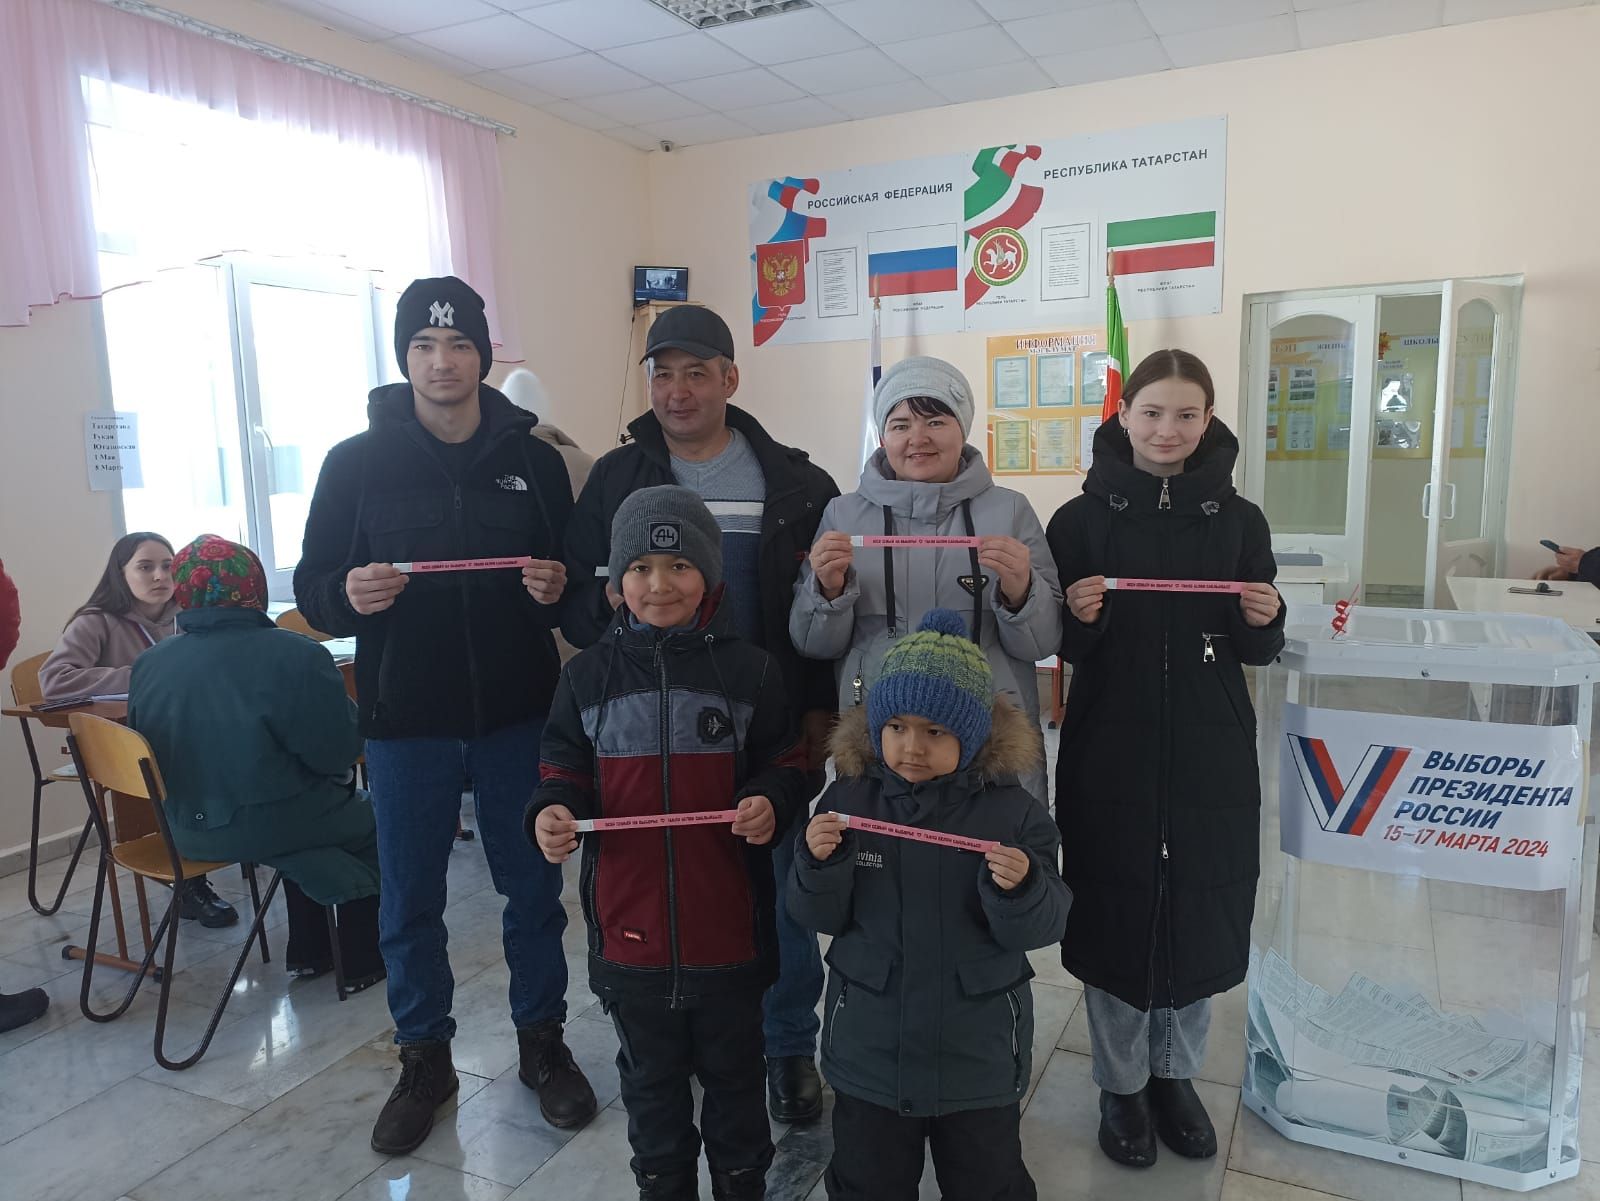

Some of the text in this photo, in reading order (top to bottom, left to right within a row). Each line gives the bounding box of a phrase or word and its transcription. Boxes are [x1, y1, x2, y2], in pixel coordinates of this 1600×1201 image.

[1043, 149, 1208, 180] РЕСПУБЛИКА ТАТАРСТАН
[807, 182, 953, 209] РОССИЙСКАЯ ФЕДЕРАЦИЯ
[429, 300, 455, 327] NY
[1016, 334, 1096, 349] ИНФОРМАЦИЯ
[1422, 750, 1546, 779] ВЫБОРЫ
[1407, 775, 1574, 808] ПРЕЗИДЕНТА
[1393, 800, 1503, 830] РОССИИ
[1383, 824, 1550, 858] 15–17 МАРТА 2024
